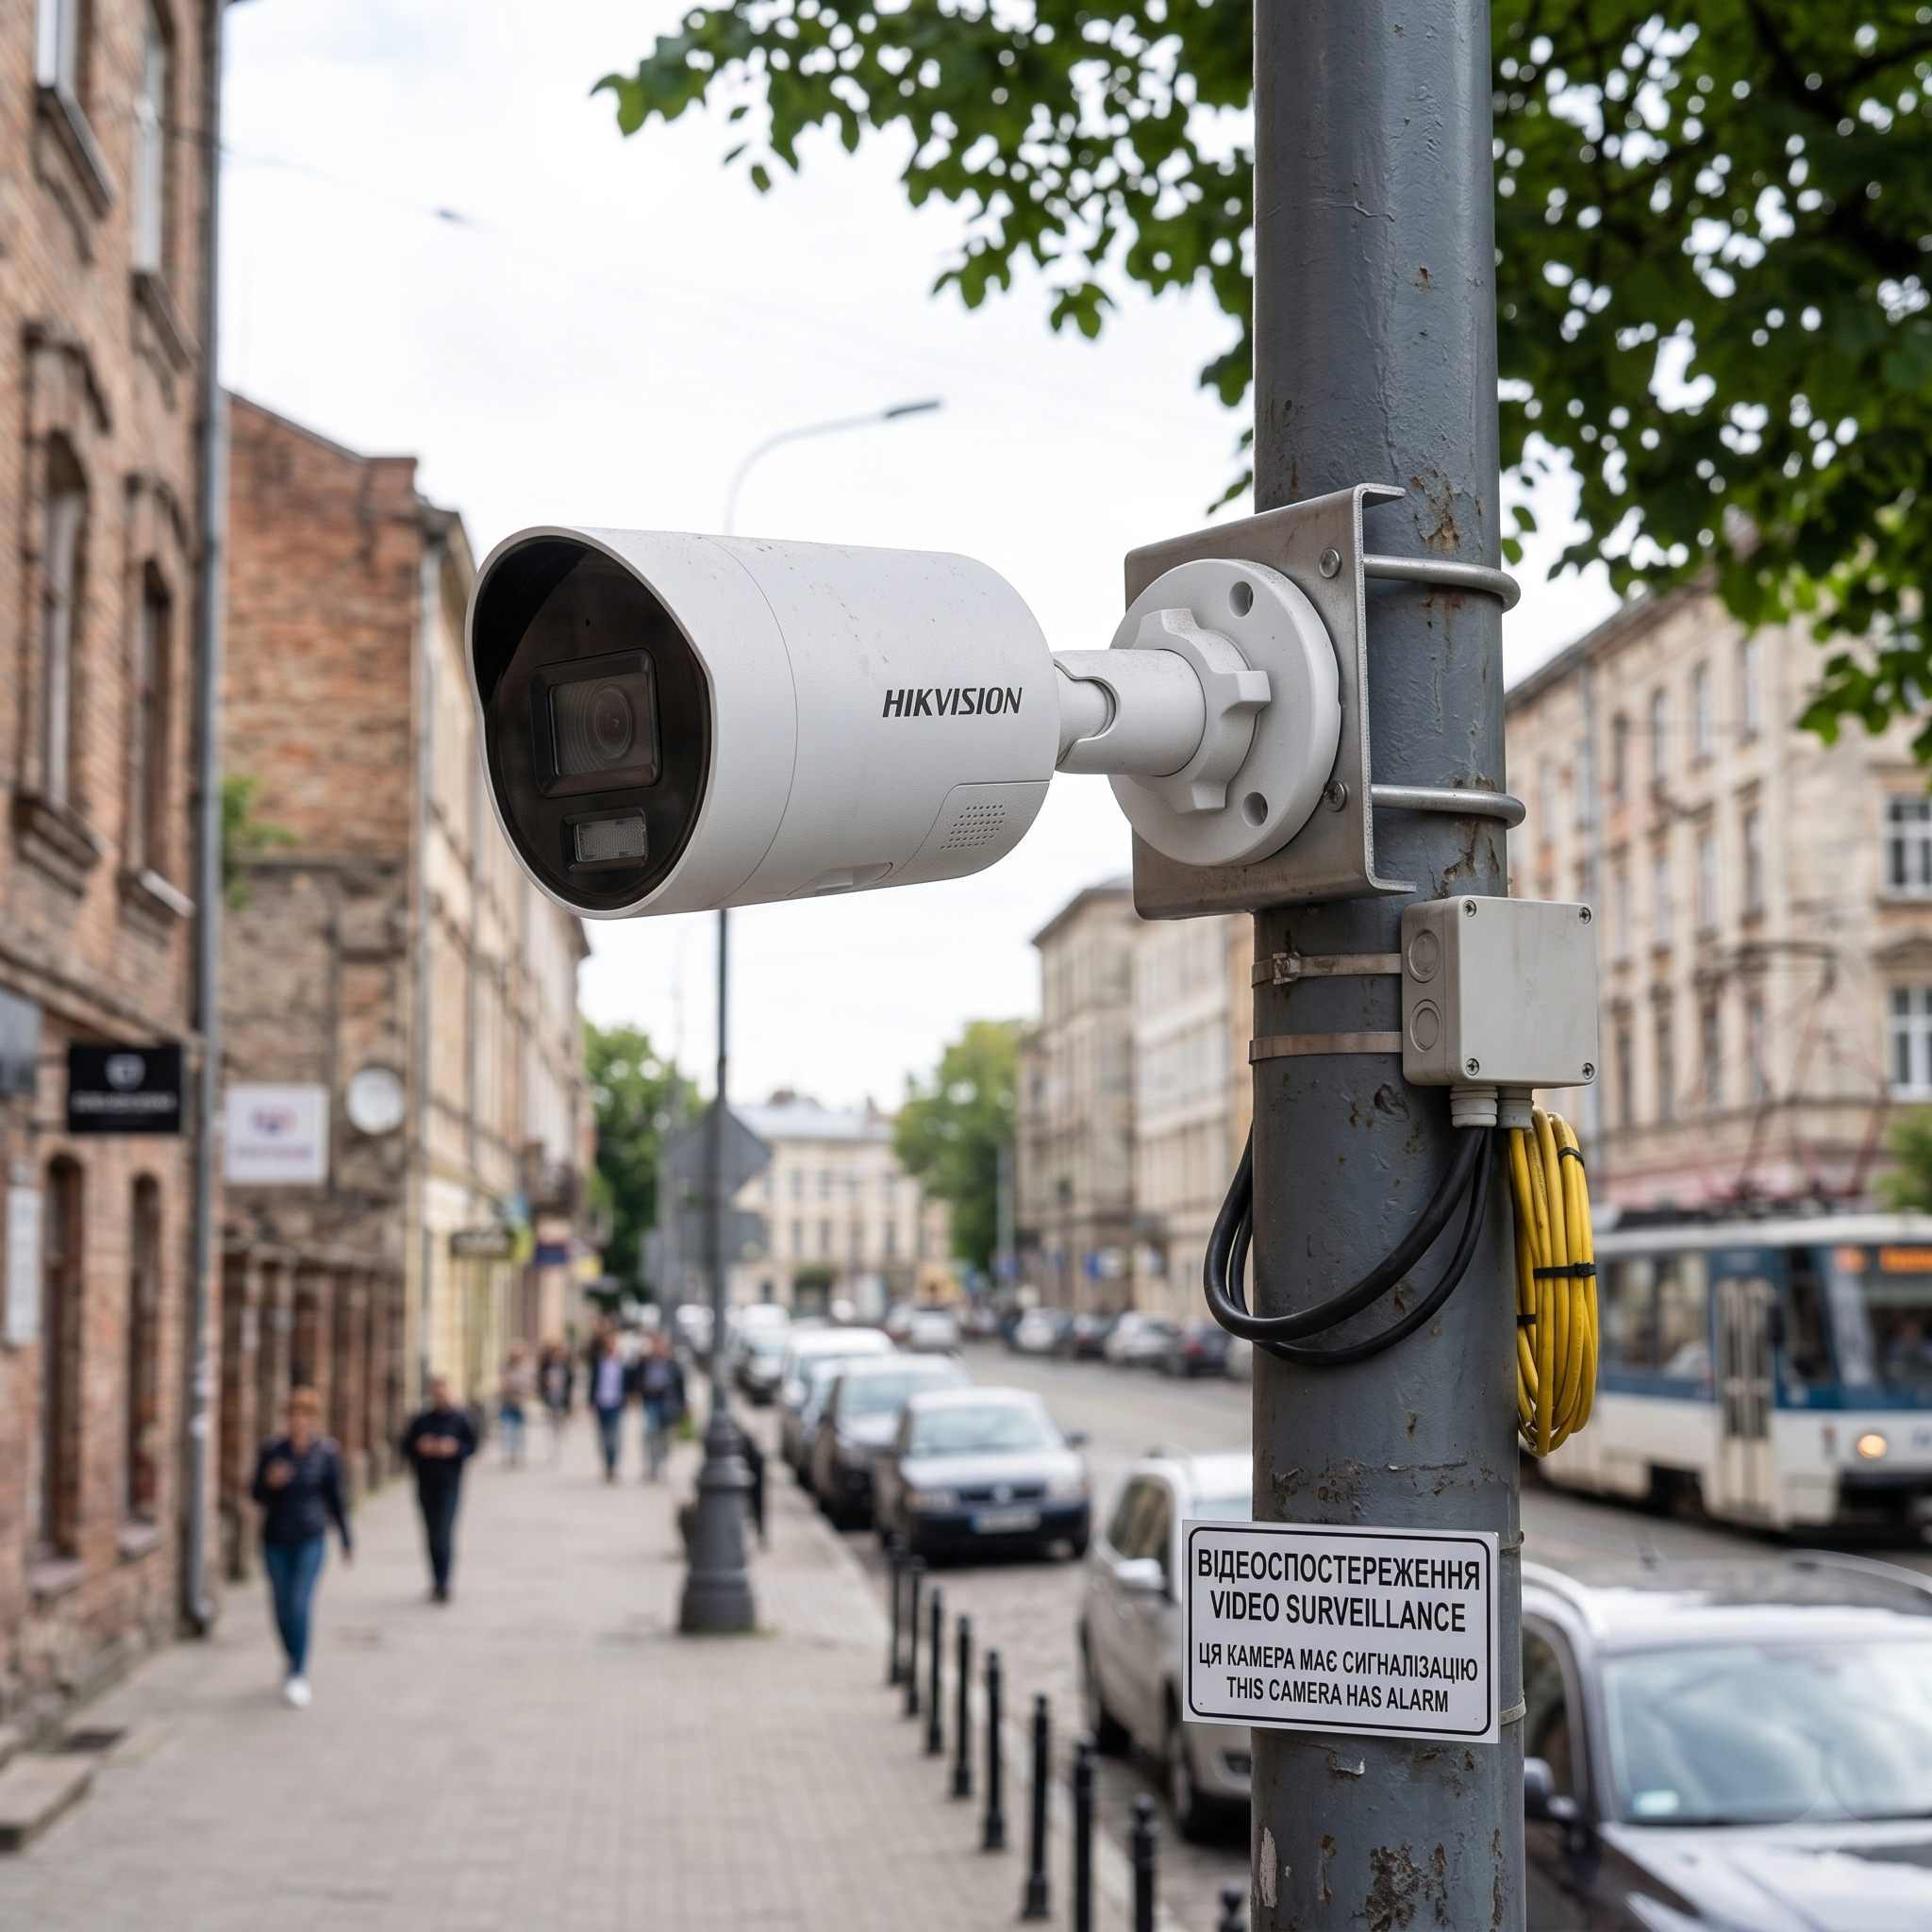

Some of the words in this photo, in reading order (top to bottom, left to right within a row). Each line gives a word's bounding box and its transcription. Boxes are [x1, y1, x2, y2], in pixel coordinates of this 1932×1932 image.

[882, 687, 1023, 718] HIKVISION
[1198, 1548, 1480, 1591] ВІДЕОСПОСТЕРЕЖЕННЯ
[1209, 1590, 1280, 1623] VIDEO
[1286, 1593, 1466, 1633] SURVEILLANCE
[1199, 1641, 1222, 1669] ЦЯ
[1227, 1643, 1296, 1671] КАМЕРА
[1300, 1648, 1338, 1673] МАЄ
[1342, 1650, 1478, 1685] СИГНАЛІЗАЦІЮ
[1226, 1675, 1264, 1700] THIS
[1269, 1678, 1342, 1706] CAMERA
[1346, 1684, 1382, 1708] HAS
[1386, 1687, 1449, 1713] ALARM
